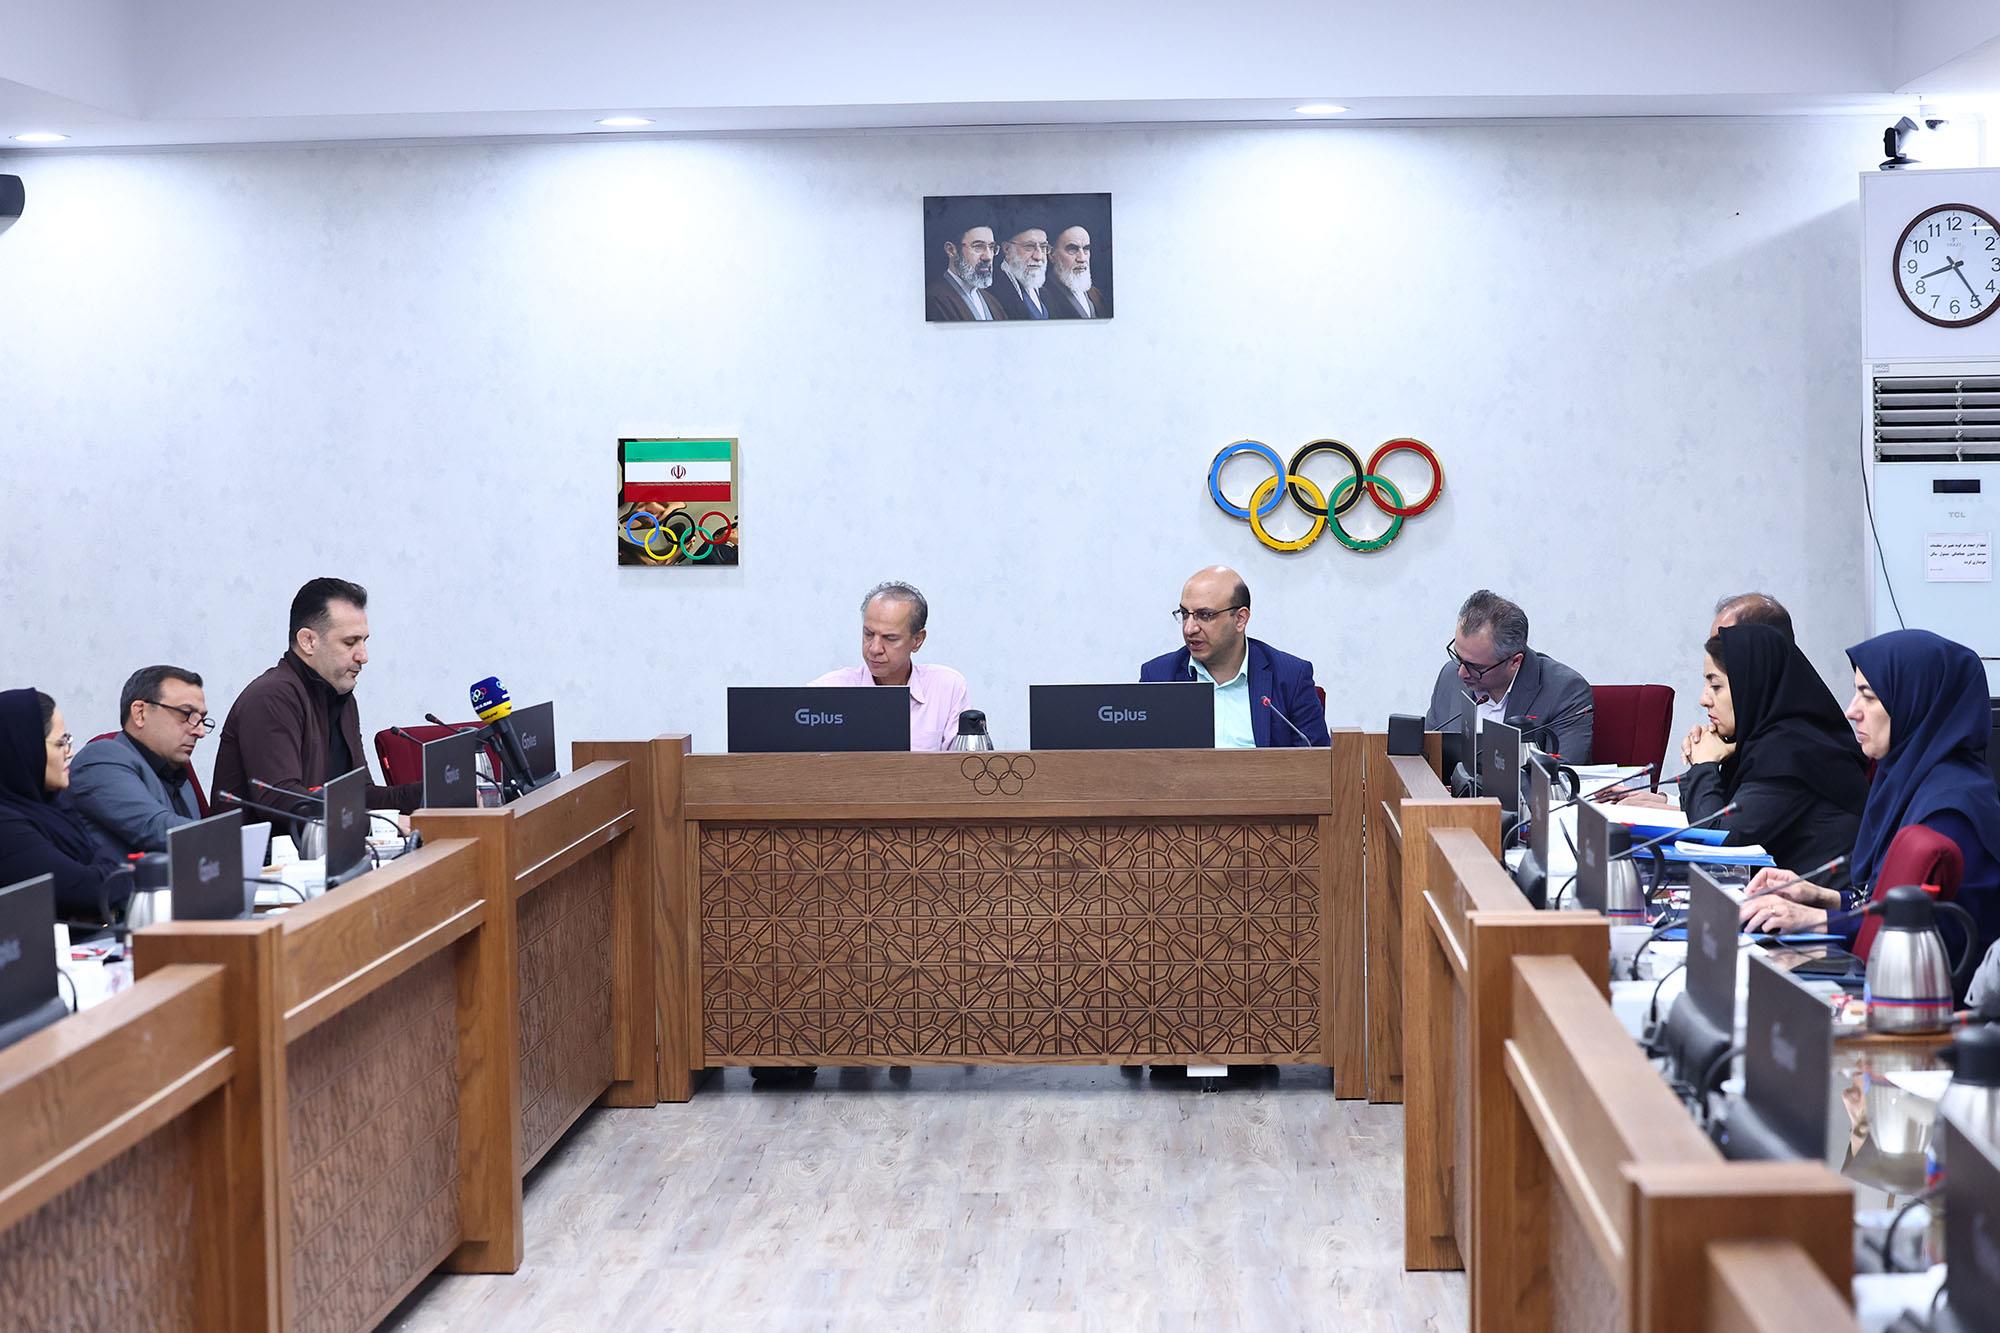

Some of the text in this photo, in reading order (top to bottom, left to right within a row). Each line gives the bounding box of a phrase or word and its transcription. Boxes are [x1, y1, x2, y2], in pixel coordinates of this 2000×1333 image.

[1927, 223, 1940, 237] 11
[1946, 216, 1962, 231] 12
[1912, 239, 1929, 254] 10
[1985, 237, 1995, 251] 2
[1907, 259, 1918, 274] 9
[1991, 257, 2000, 272] 3
[1915, 280, 1926, 294] 8
[1985, 279, 1996, 293] 4
[1930, 295, 1940, 309] 7
[1949, 299, 1960, 314] 6
[1970, 295, 1980, 309] 5
[794, 708, 843, 727] Gplus
[1098, 705, 1147, 724] Gplus
